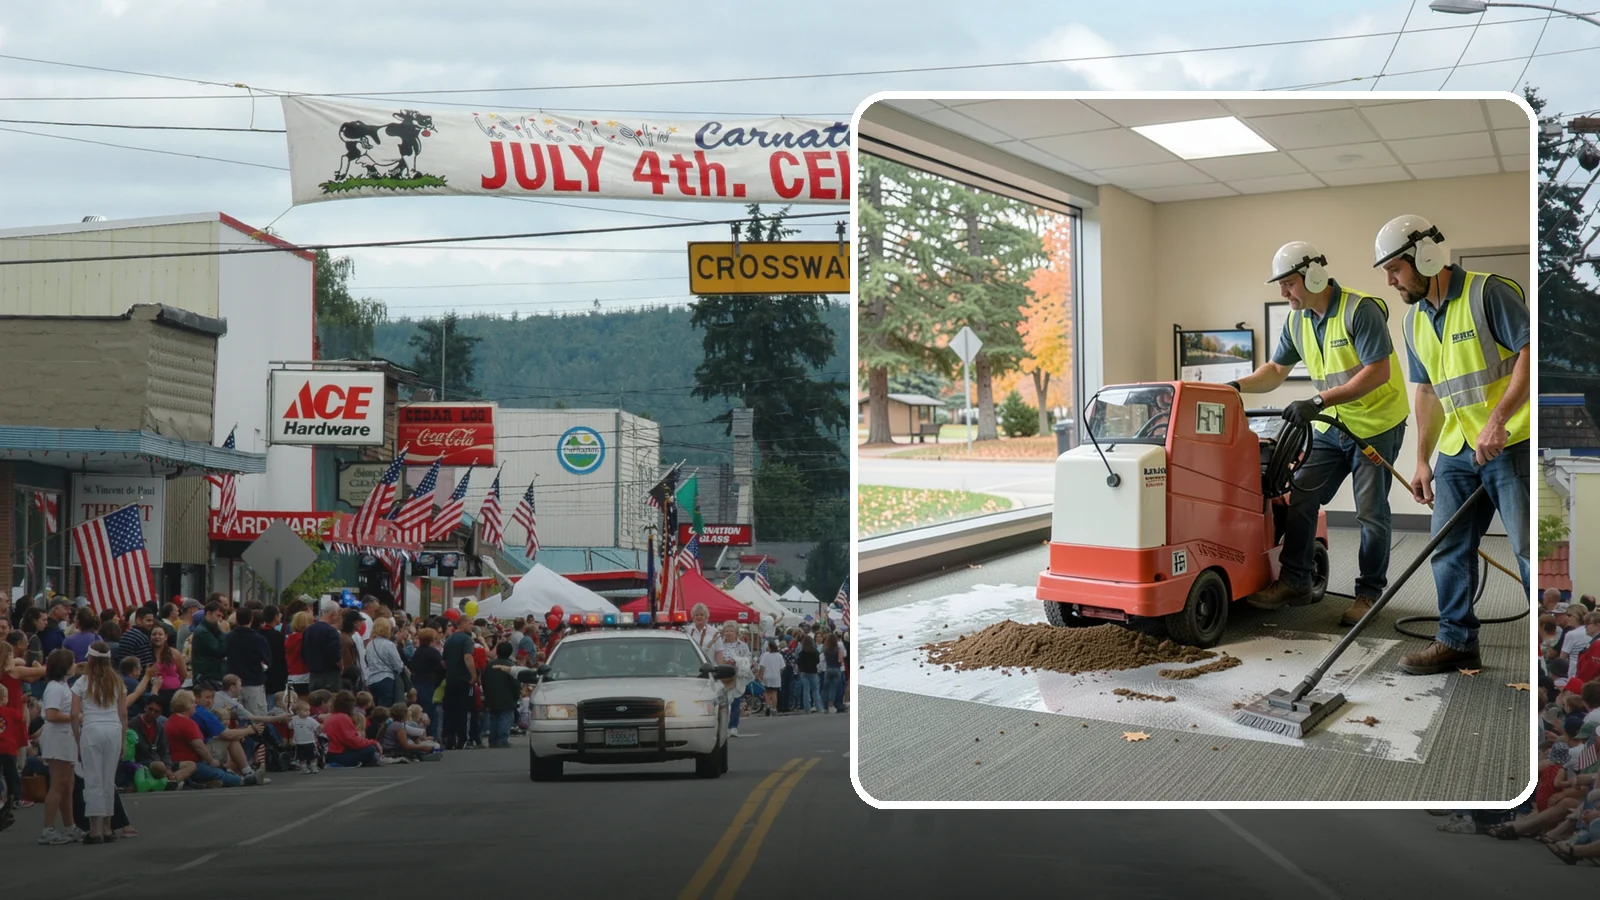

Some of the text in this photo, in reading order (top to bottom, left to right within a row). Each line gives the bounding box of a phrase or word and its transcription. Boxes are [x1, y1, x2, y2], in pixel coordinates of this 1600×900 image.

[481, 141, 604, 191] JULY
[632, 150, 746, 198] 4th.
[697, 254, 850, 280] CROSSWA
[283, 380, 373, 420] ACE
[406, 409, 485, 422] CEDAR LOG
[283, 421, 371, 436] Hardware
[416, 428, 477, 447] Coca-Cola
[353, 467, 385, 480] Simpl
[95, 485, 124, 495] Vincent
[126, 486, 136, 495] de
[137, 486, 155, 495] Paul
[688, 526, 741, 535] CRNATION
[699, 535, 730, 544] GLASS
